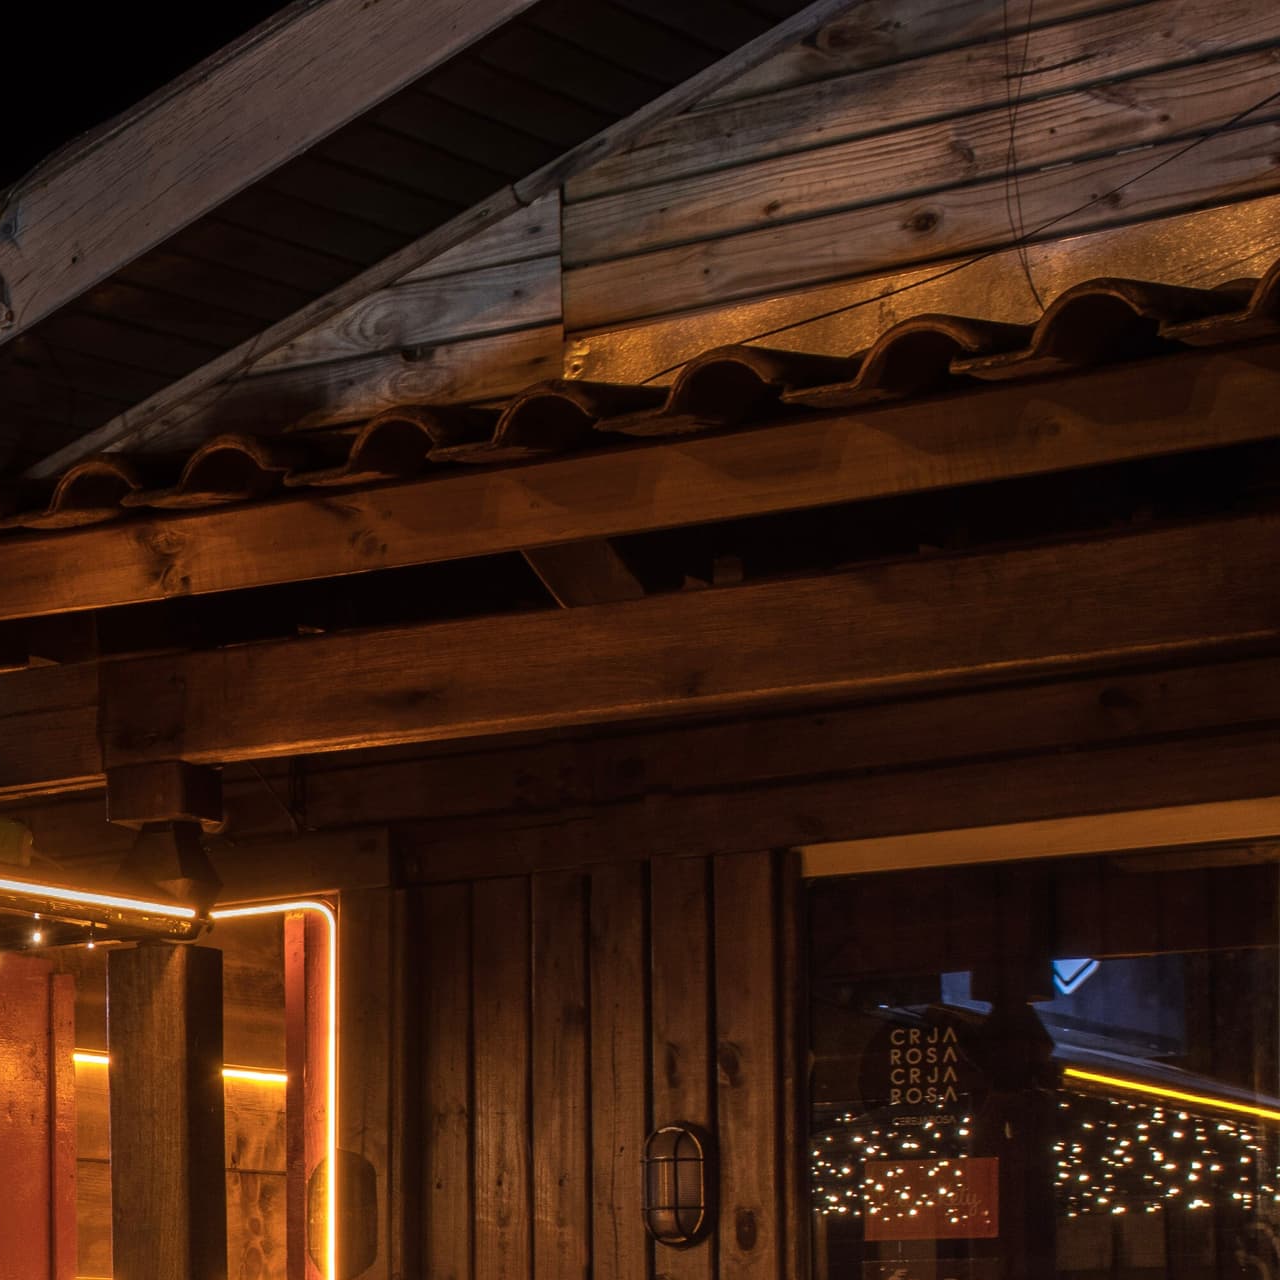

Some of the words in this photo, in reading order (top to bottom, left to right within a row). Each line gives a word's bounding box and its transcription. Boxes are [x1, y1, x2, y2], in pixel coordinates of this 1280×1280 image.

[890, 1026, 958, 1046] CRJA
[890, 1046, 958, 1065] ROSA
[890, 1065, 958, 1085] CRJA
[890, 1085, 958, 1104] ROSA
